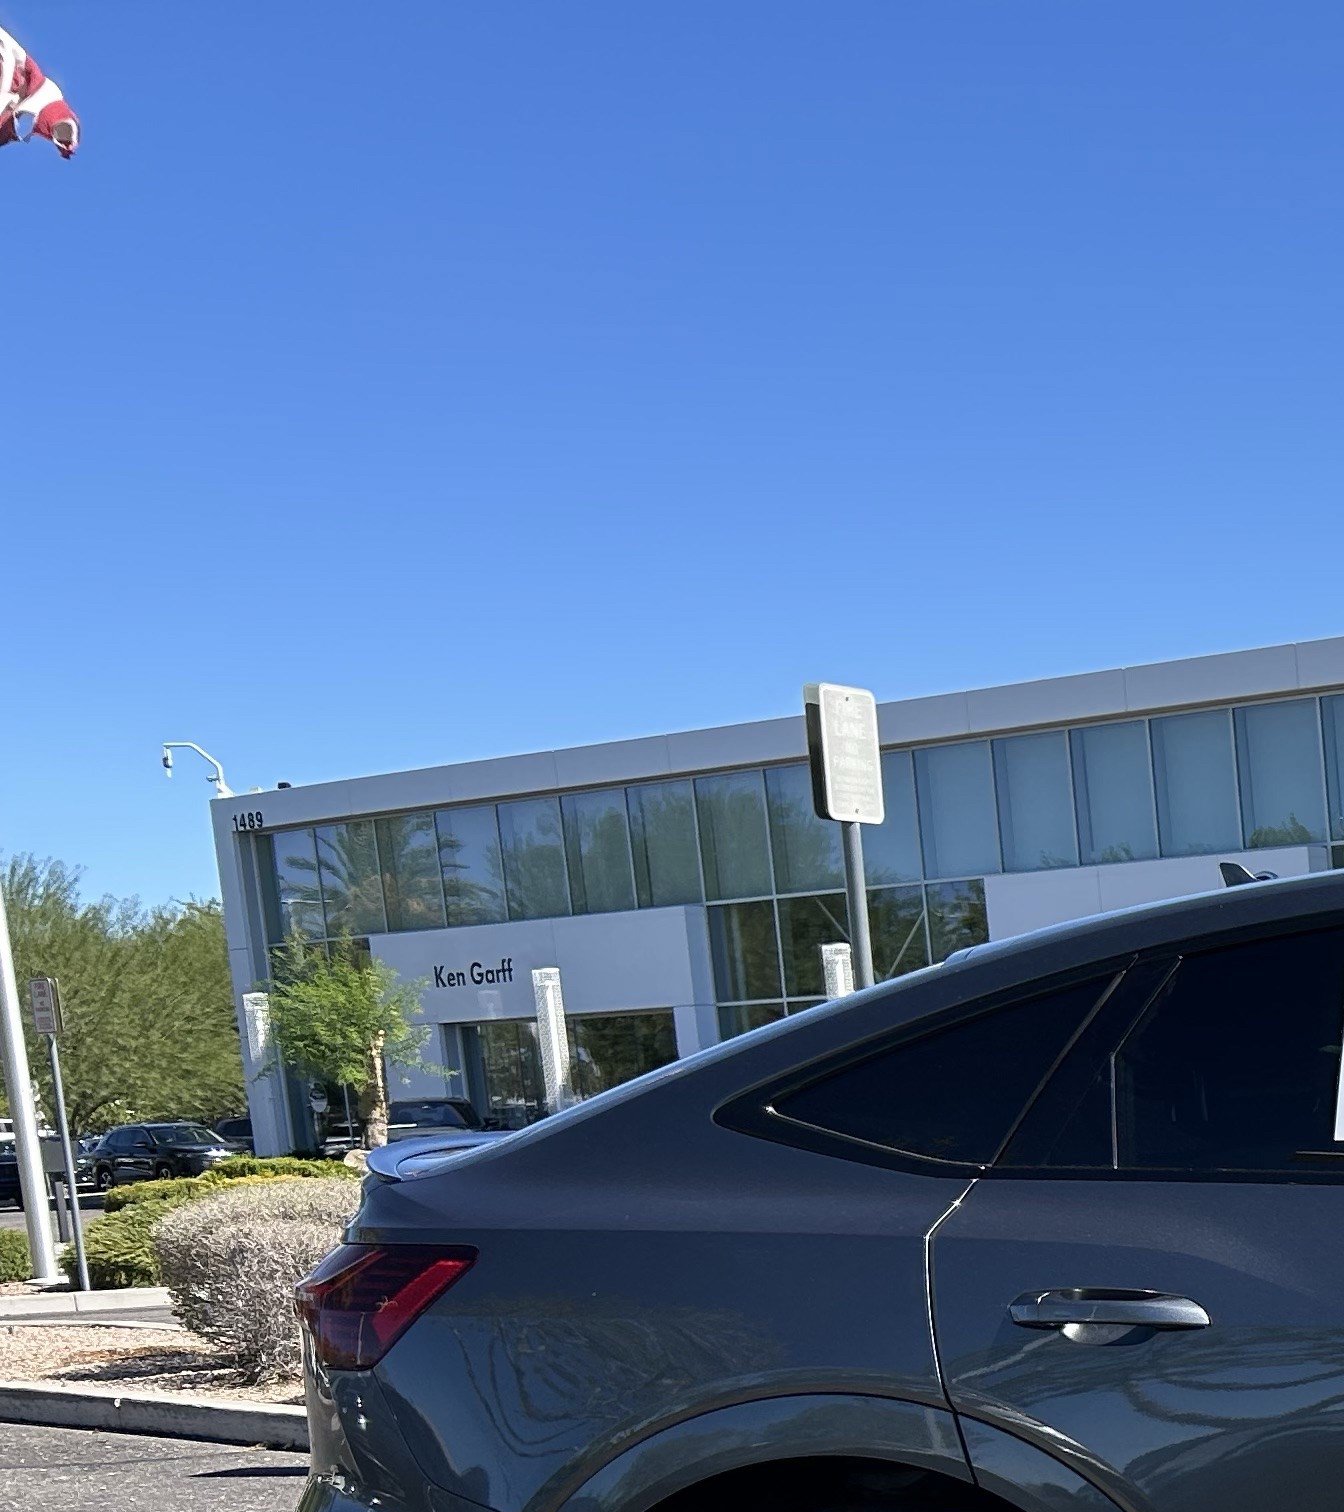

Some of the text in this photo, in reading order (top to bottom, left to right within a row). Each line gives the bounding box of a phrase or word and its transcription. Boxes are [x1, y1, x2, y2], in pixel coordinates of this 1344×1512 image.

[833, 720, 866, 739] LANE
[232, 811, 263, 831] 1489
[433, 957, 514, 988] Ken Garff
